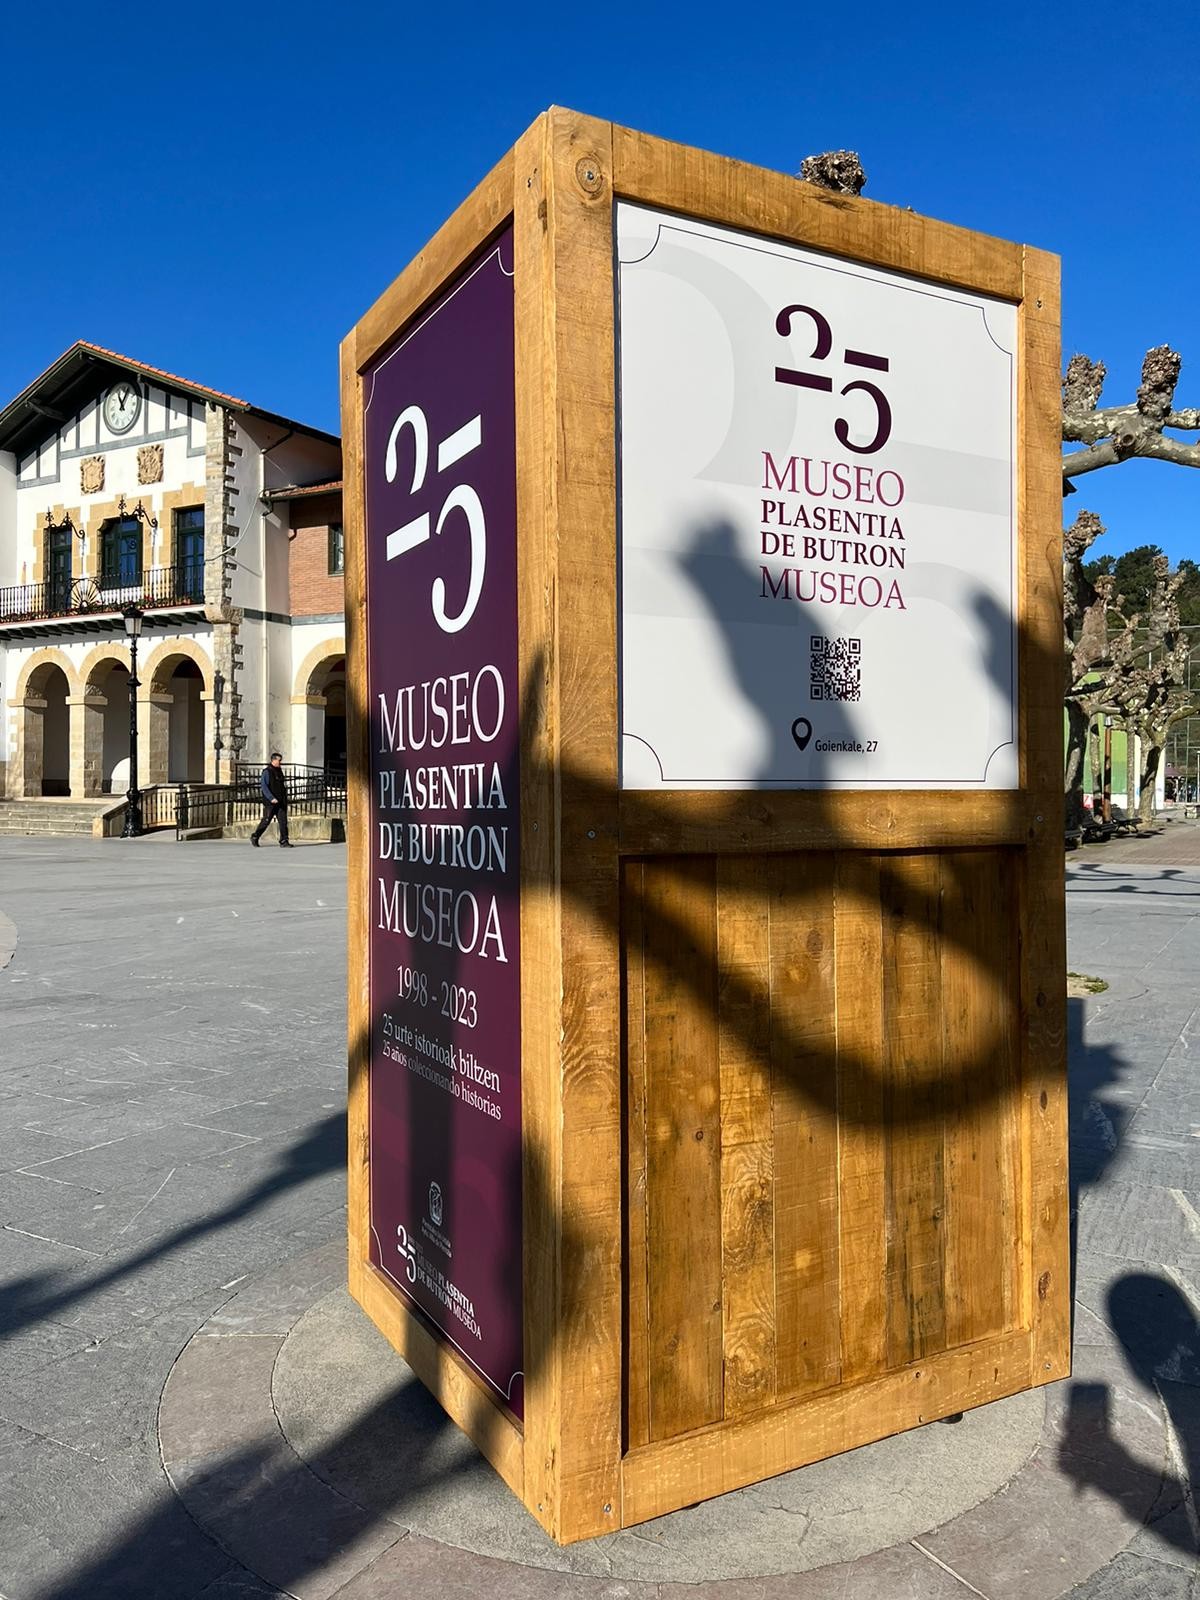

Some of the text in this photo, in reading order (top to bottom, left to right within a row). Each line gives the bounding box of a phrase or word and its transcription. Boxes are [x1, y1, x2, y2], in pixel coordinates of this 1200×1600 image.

[761, 450, 905, 507] MUSEO
[760, 499, 906, 540] PLASENTIA
[760, 531, 906, 569] DE BUTRON
[759, 565, 907, 610] MUSEOA
[378, 665, 505, 753] MUSEO
[815, 740, 878, 754] Goienkale, 27
[379, 762, 507, 809] PLASENTIA
[379, 822, 508, 873] DE BUTRON
[378, 878, 508, 963] MUSEOA
[397, 965, 428, 1008] 1998
[441, 981, 478, 1029] 2023
[382, 1013, 501, 1094] 25 urte istorioak biltzen
[382, 1039, 502, 1121] 25 años coleccionando historias
[438, 1273, 475, 1318] PLASENTIA
[452, 1303, 482, 1341] MUSEOA
